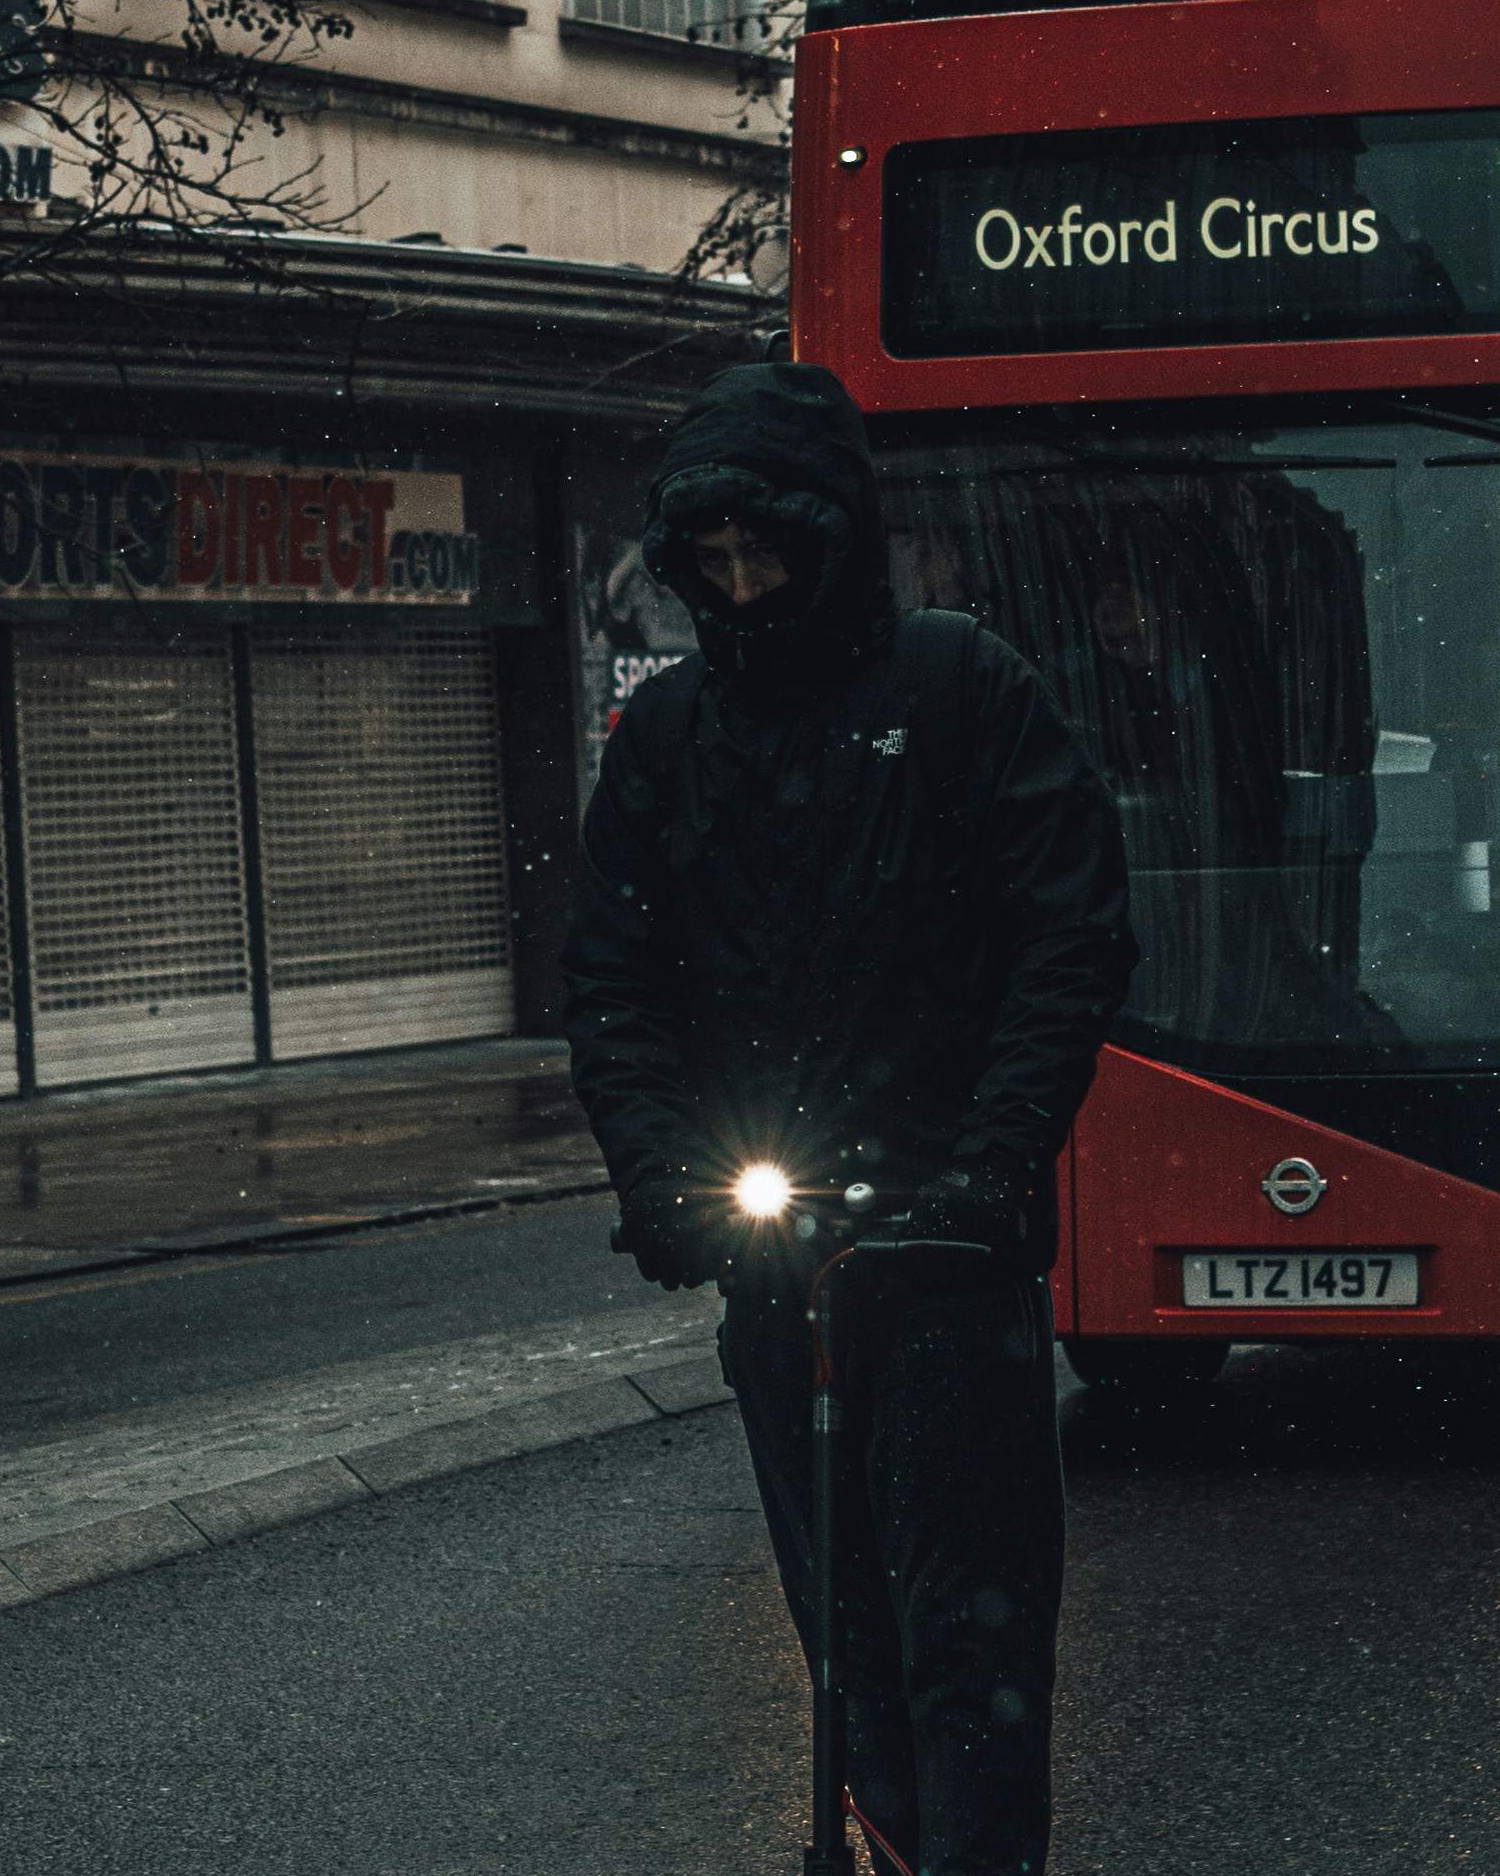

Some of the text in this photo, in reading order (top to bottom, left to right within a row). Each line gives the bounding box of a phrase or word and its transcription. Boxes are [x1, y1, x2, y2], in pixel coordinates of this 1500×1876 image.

[974, 201, 1177, 271] Oxford
[1200, 197, 1381, 261] Circus
[613, 656, 686, 698] SPO
[1208, 1259, 1393, 1300] LTZ 1497
